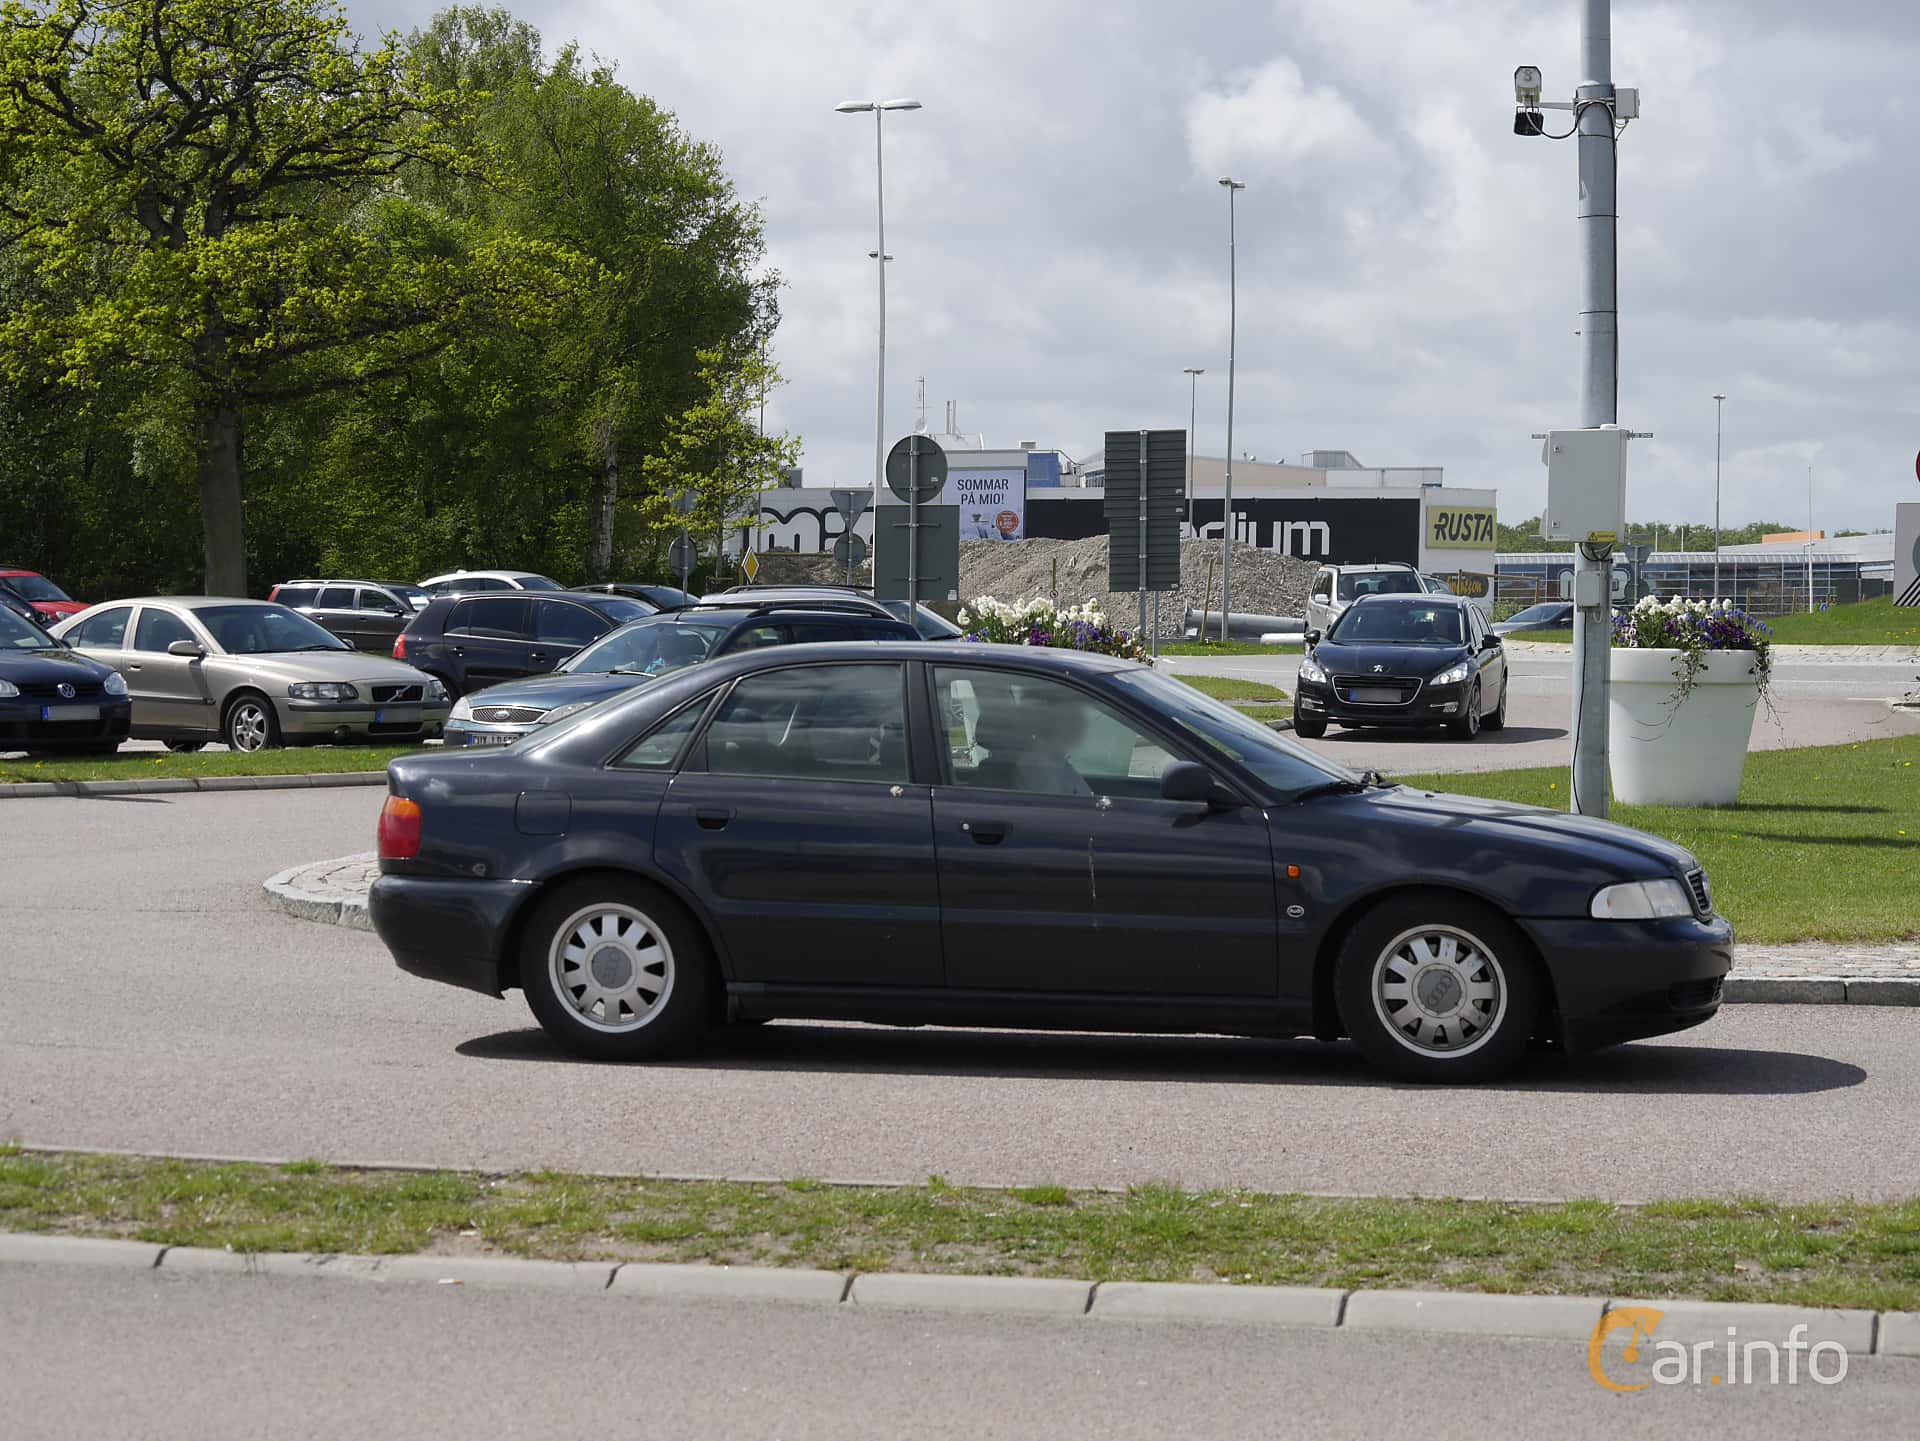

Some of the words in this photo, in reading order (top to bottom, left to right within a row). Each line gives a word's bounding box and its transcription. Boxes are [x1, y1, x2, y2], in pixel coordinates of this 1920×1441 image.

[957, 478, 1009, 491] SOMMAR
[961, 491, 976, 505] PÅ
[979, 493, 1005, 505] MIO!
[1434, 512, 1494, 543] RUSTA
